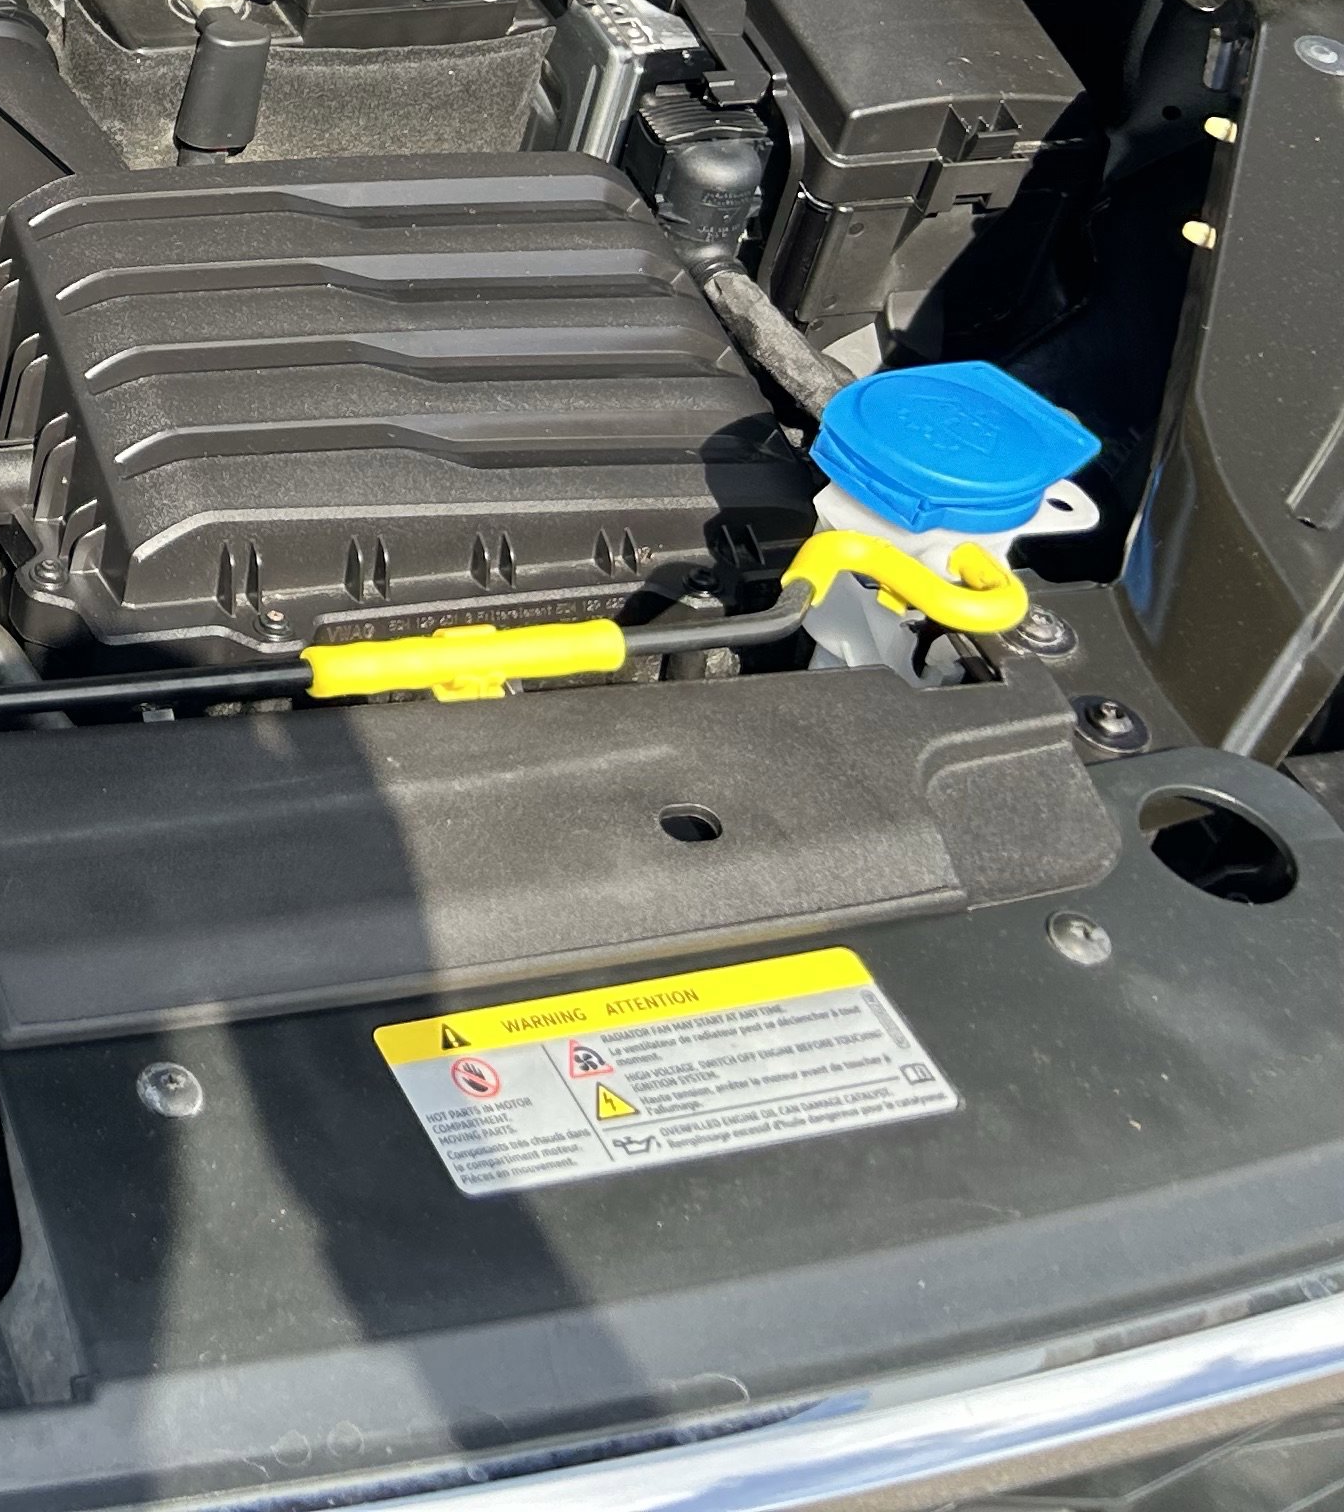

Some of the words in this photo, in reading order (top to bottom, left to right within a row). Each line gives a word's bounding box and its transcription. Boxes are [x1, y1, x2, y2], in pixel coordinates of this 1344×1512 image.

[501, 1007, 587, 1033] WARNING
[605, 988, 700, 1016] ATTENTION
[599, 1027, 651, 1043] RADIATOR
[649, 1023, 672, 1034] FAN
[670, 1019, 695, 1030] MAY
[692, 1014, 725, 1027] START
[722, 1012, 738, 1021] AT
[623, 1070, 652, 1082] HIGH
[630, 1076, 678, 1093] IGNITION
[424, 1111, 449, 1123] HOT
[447, 1105, 482, 1119] PARTS
[479, 1103, 494, 1113] IN
[493, 1096, 533, 1111] MOTOR
[430, 1112, 512, 1135] COMPARTMENT.
[436, 1130, 482, 1146] MOVING
[480, 1123, 518, 1138] PARTS.
